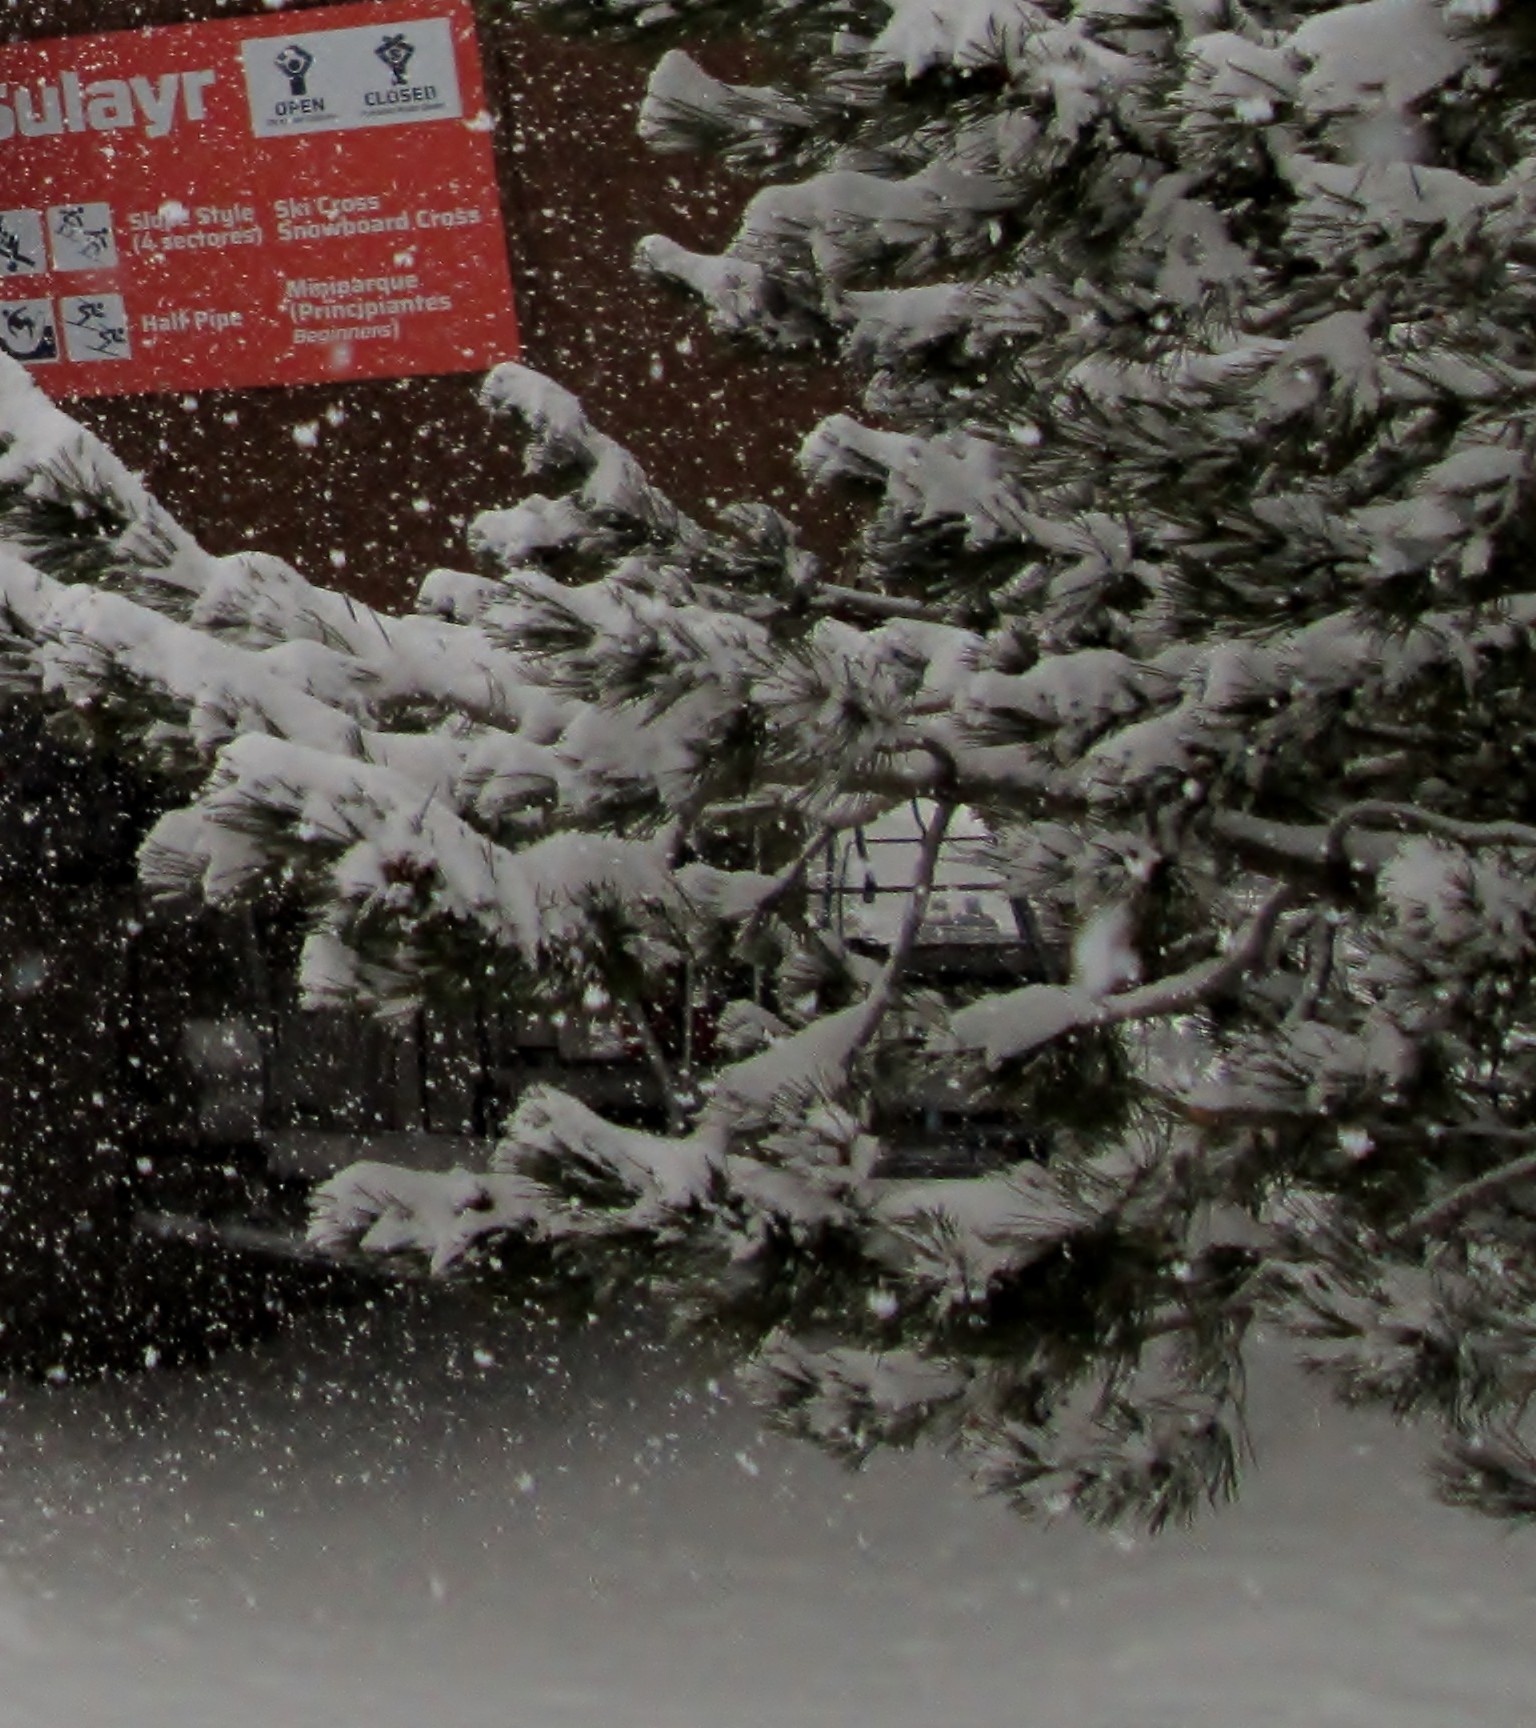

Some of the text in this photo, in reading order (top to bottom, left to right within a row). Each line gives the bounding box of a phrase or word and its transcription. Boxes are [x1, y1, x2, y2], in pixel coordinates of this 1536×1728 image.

[275, 97, 325, 116] OPEN
[364, 85, 437, 106] CLOSED
[195, 203, 255, 228] Style
[274, 194, 380, 220] Ski Cross
[277, 206, 481, 242] Snowboard Cross
[161, 225, 263, 252] sectores)
[141, 309, 244, 333] Half Pipe
[293, 318, 401, 345] Beginners)
